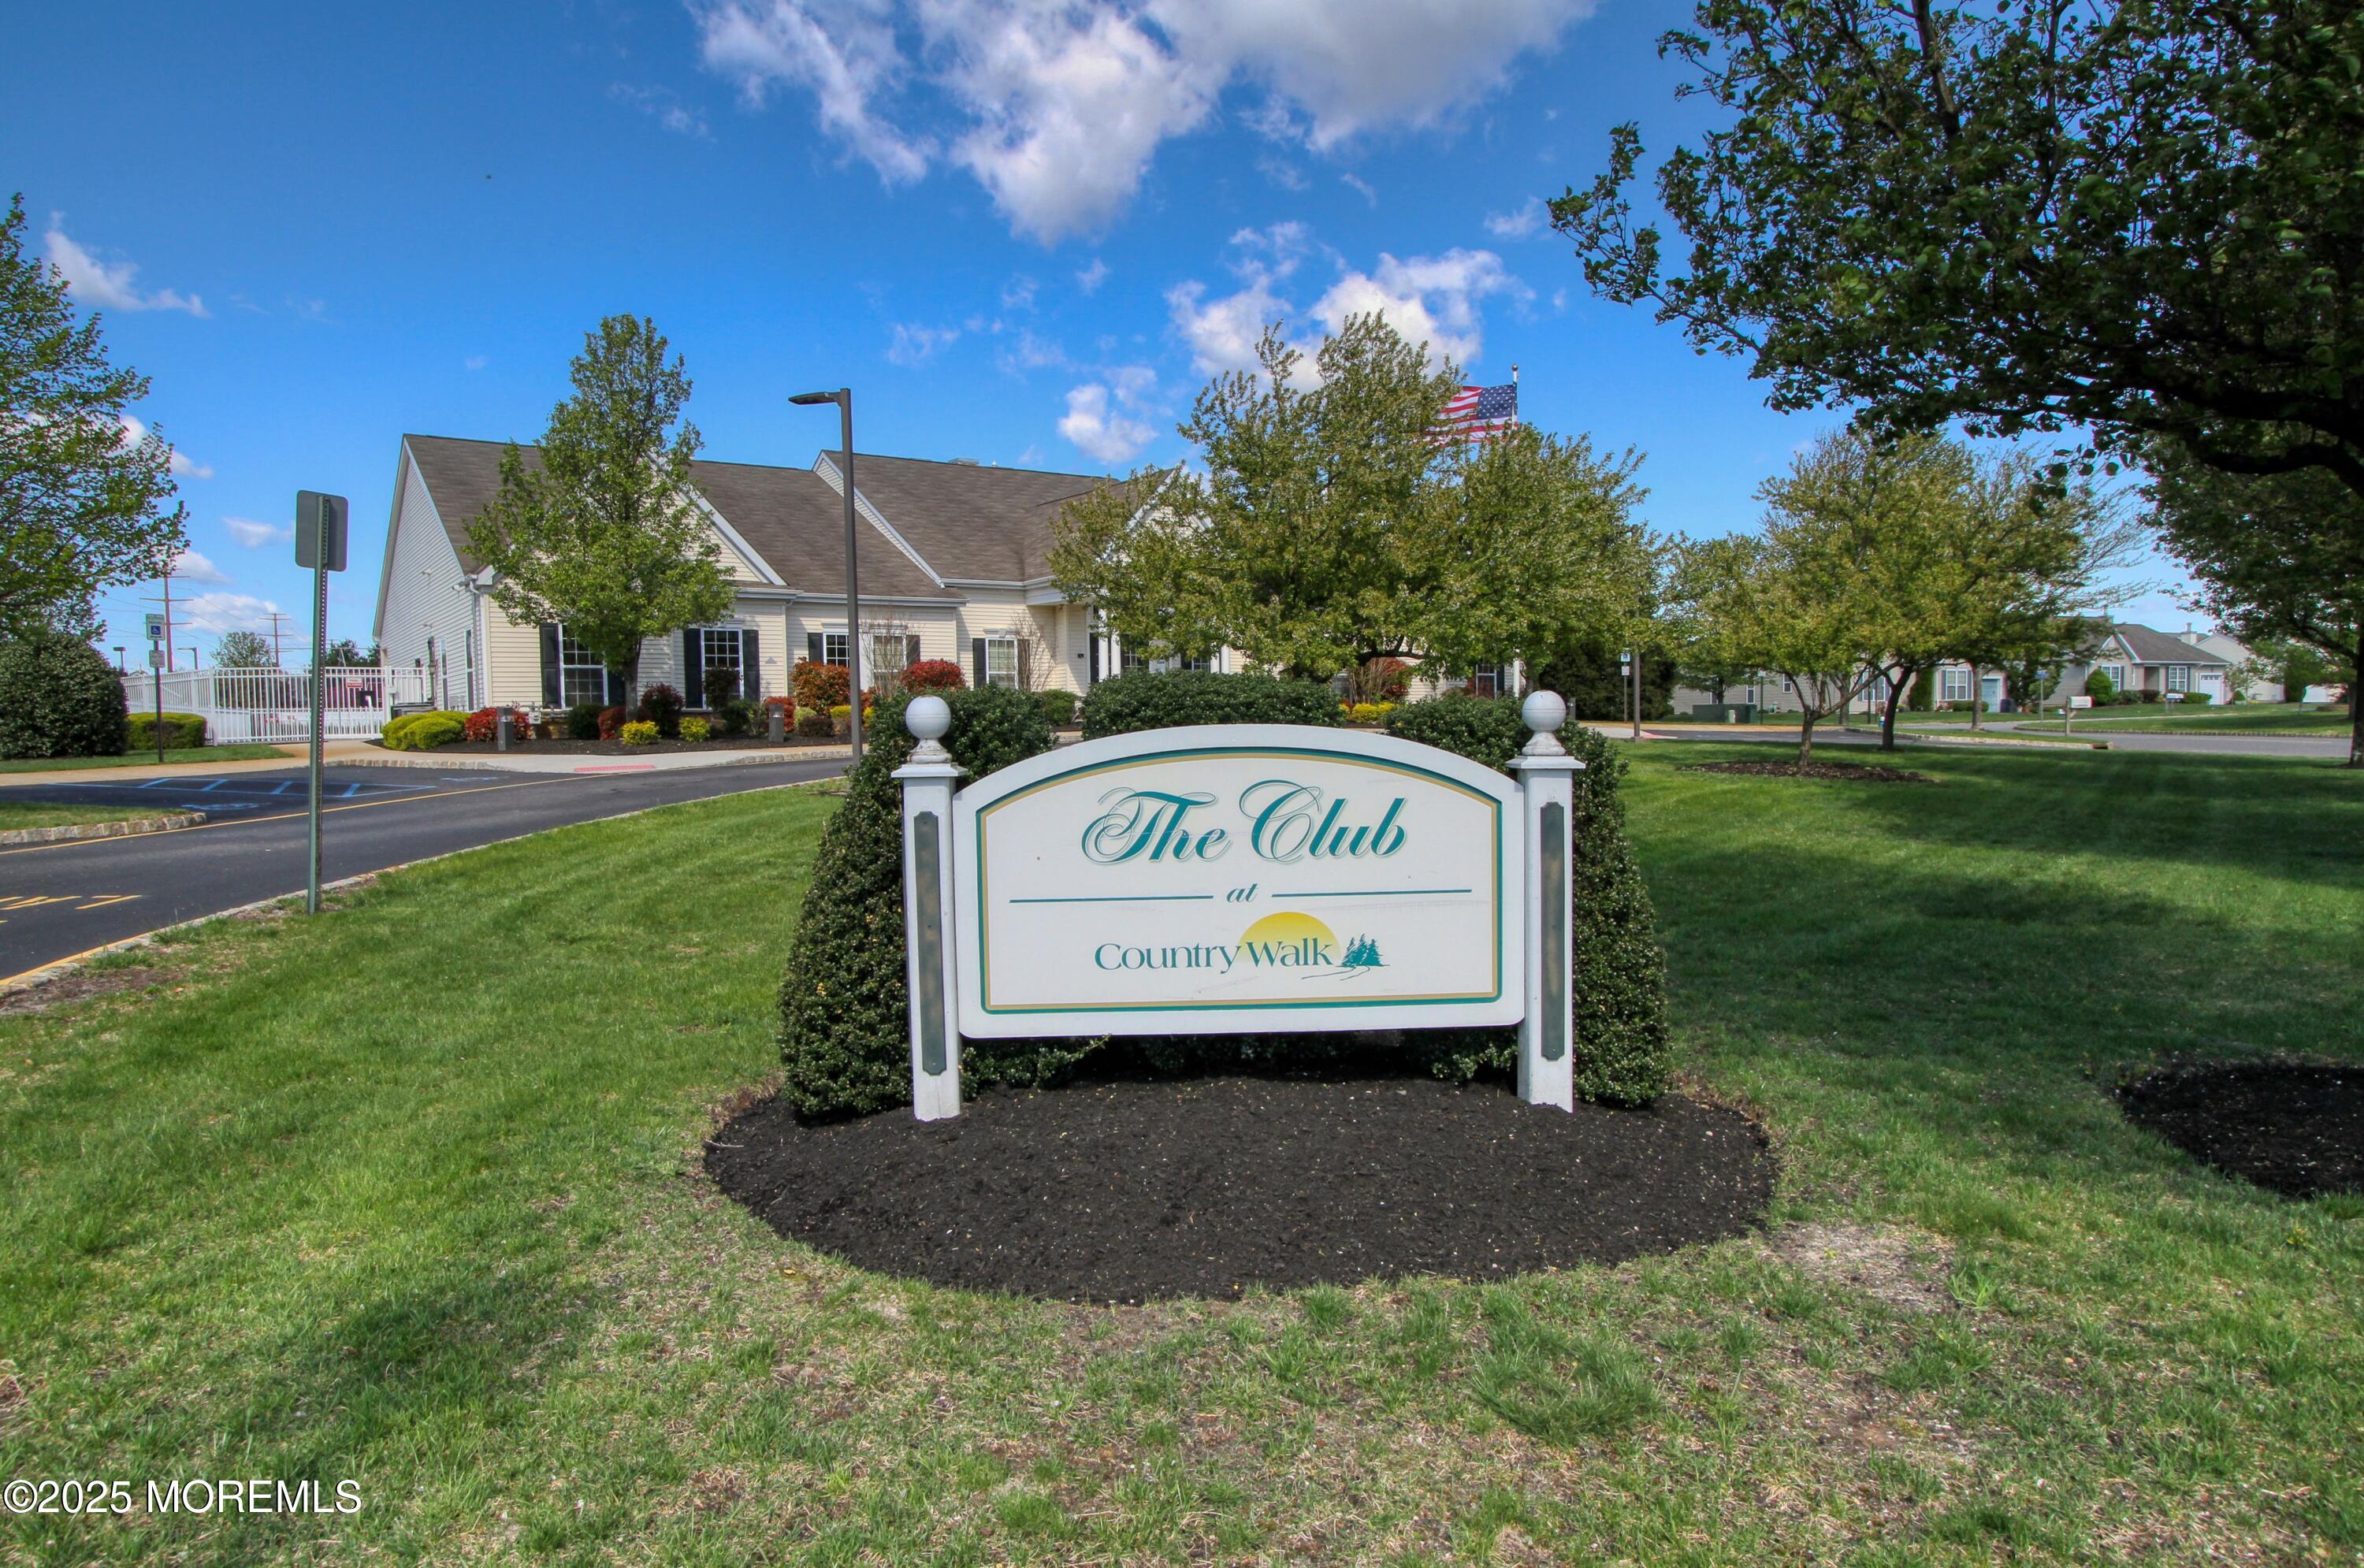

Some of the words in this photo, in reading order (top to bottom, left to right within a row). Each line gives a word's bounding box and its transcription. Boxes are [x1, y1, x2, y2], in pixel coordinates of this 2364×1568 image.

[1081, 786, 1232, 864] The
[1239, 779, 1407, 863] Club
[1226, 883, 1258, 903] at
[1095, 942, 1243, 974] Country
[1245, 937, 1334, 968] Walk
